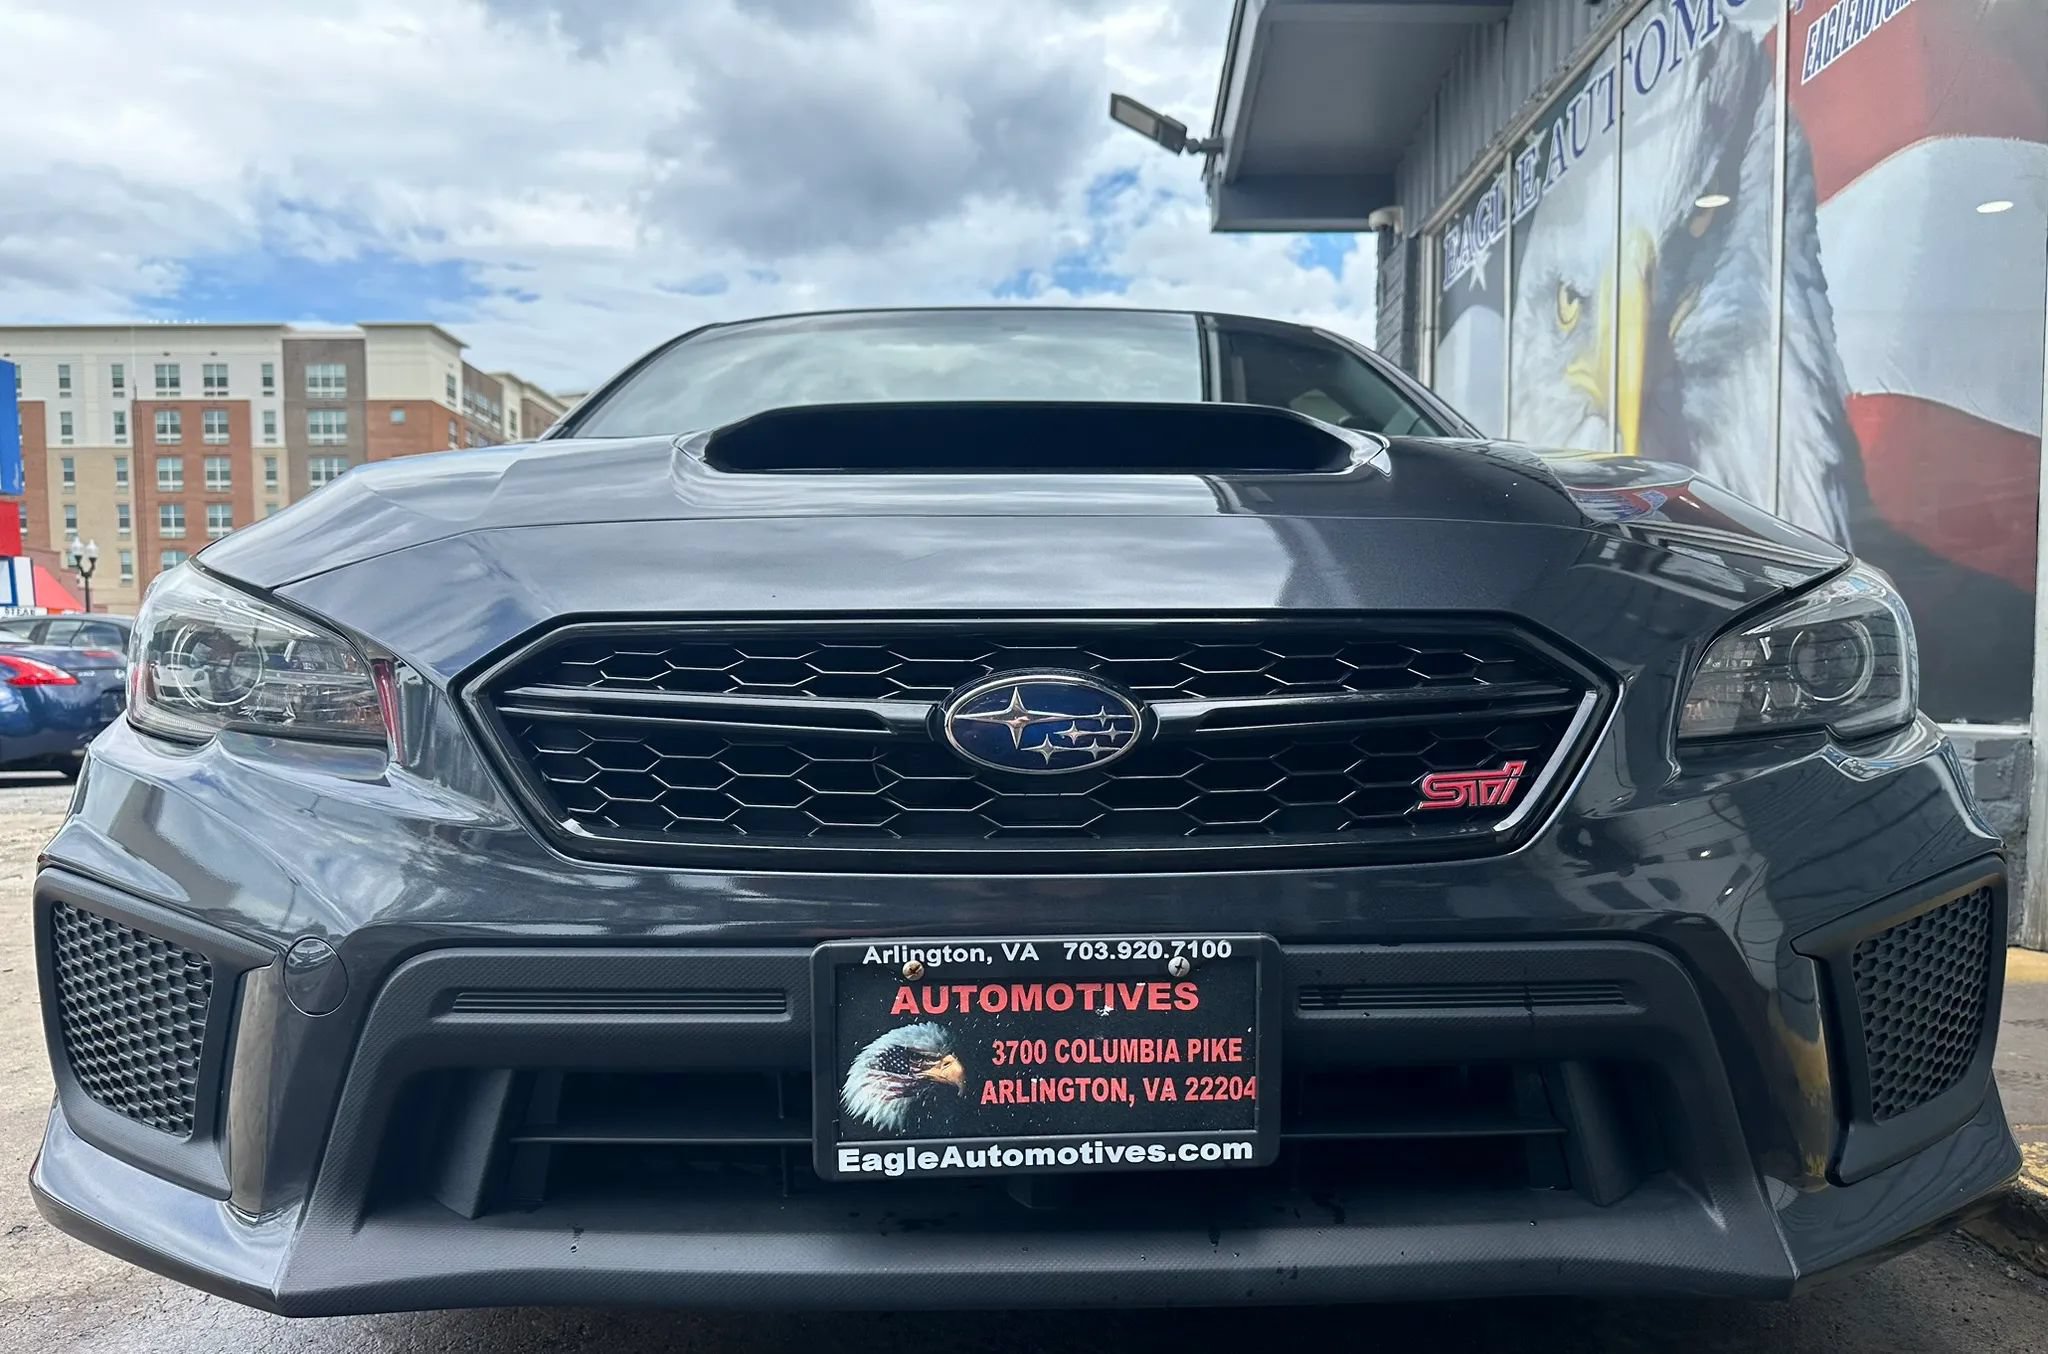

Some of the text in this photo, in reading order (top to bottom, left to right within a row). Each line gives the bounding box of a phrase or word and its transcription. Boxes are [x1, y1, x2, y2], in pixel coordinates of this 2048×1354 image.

[1443, 0, 1753, 290] EAGLE AUTOM
[862, 940, 1232, 967] Arlington, VA 703.920.7100
[890, 983, 1199, 1015] AUTOMOTIVES
[992, 1038, 1243, 1065] 3700 COLUMBIA PIKE
[980, 1076, 1257, 1108] ARLINGTON, VA 22204
[837, 1141, 1253, 1176] EagleAutomotives.com
